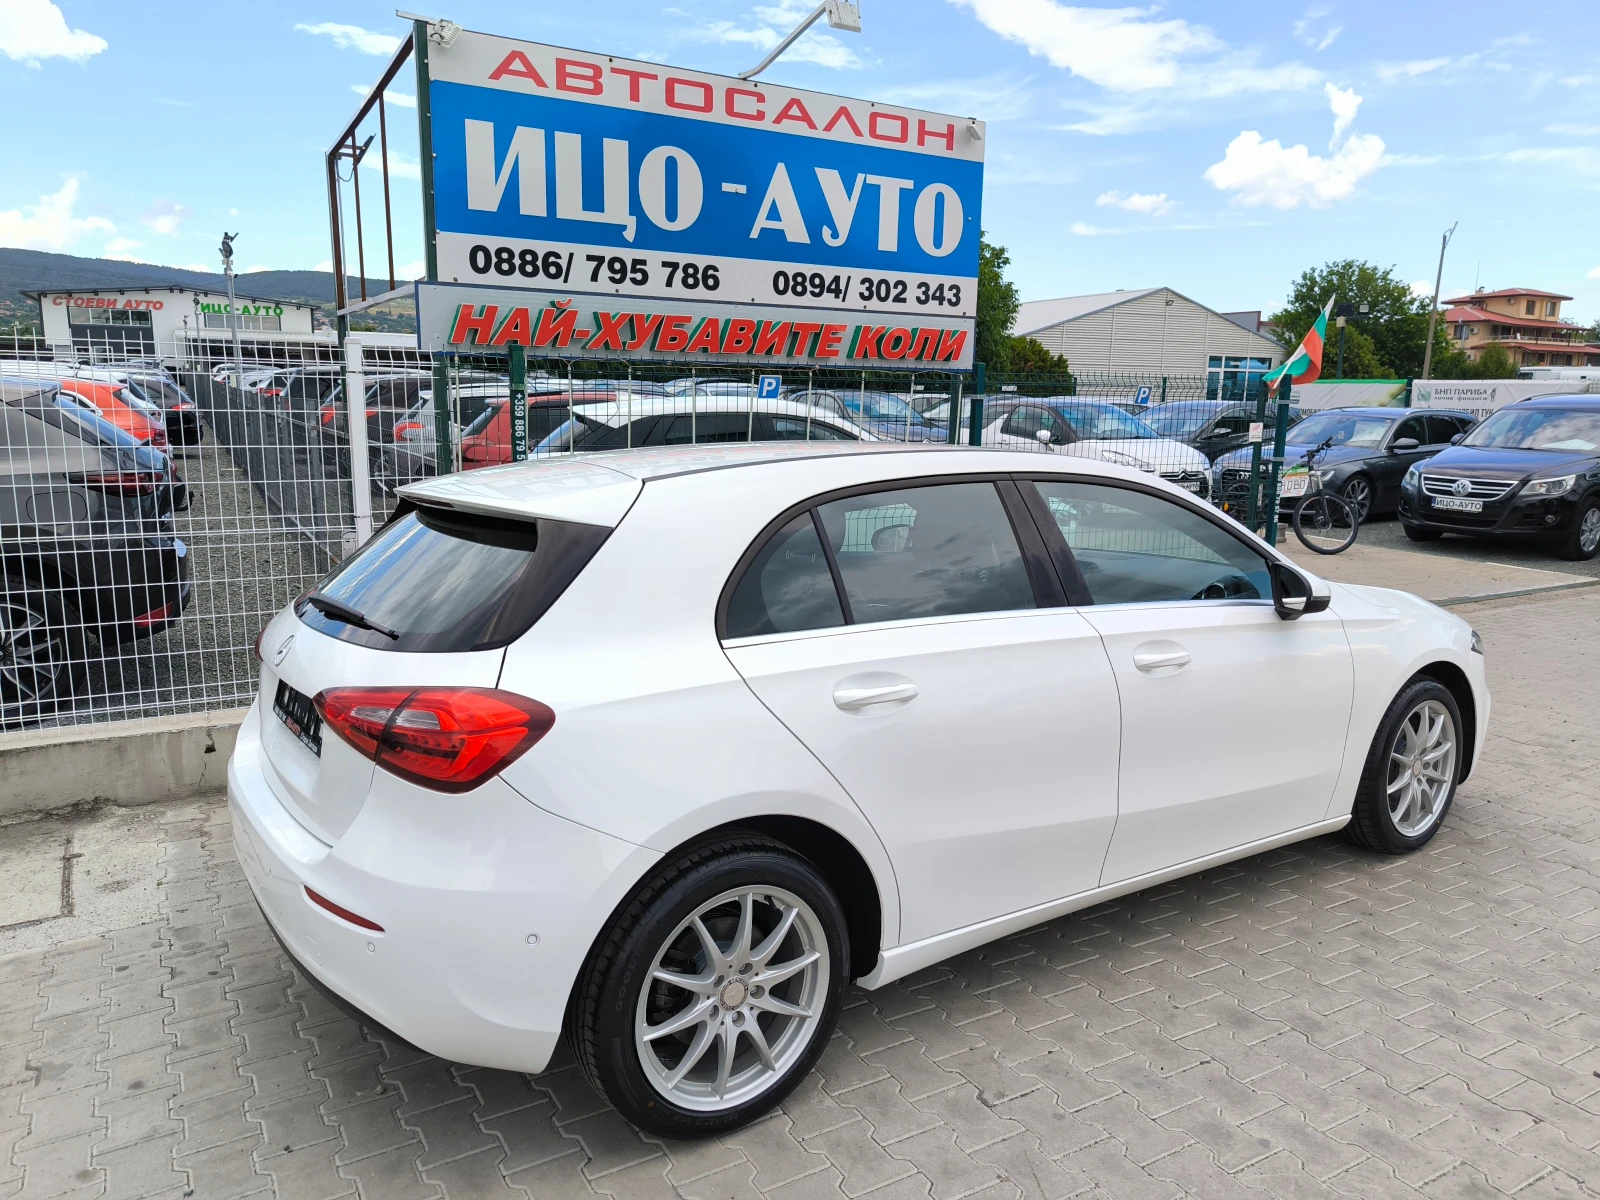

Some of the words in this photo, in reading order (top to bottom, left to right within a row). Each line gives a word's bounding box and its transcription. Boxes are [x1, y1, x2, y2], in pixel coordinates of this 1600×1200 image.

[488, 50, 955, 152] АВТОСАЛОН
[468, 244, 575, 284] 0886/
[585, 254, 649, 286] 795
[661, 260, 720, 292] 786
[772, 270, 852, 303] 0894/
[858, 277, 908, 304] 302
[915, 282, 961, 307] 343
[52, 296, 118, 310] СТОЕВИ
[123, 299, 164, 311] АУТО
[448, 299, 848, 360] НАЙ-ХУБАВИТЕ
[851, 325, 969, 362] КОЛИ
[1453, 388, 1488, 396] ПАРИБА
[514, 393, 525, 417] +359
[514, 419, 524, 437] 886
[515, 440, 525, 451] 79
[516, 454, 526, 462] 5
[1436, 499, 1482, 511] ИЦО-АУТО
